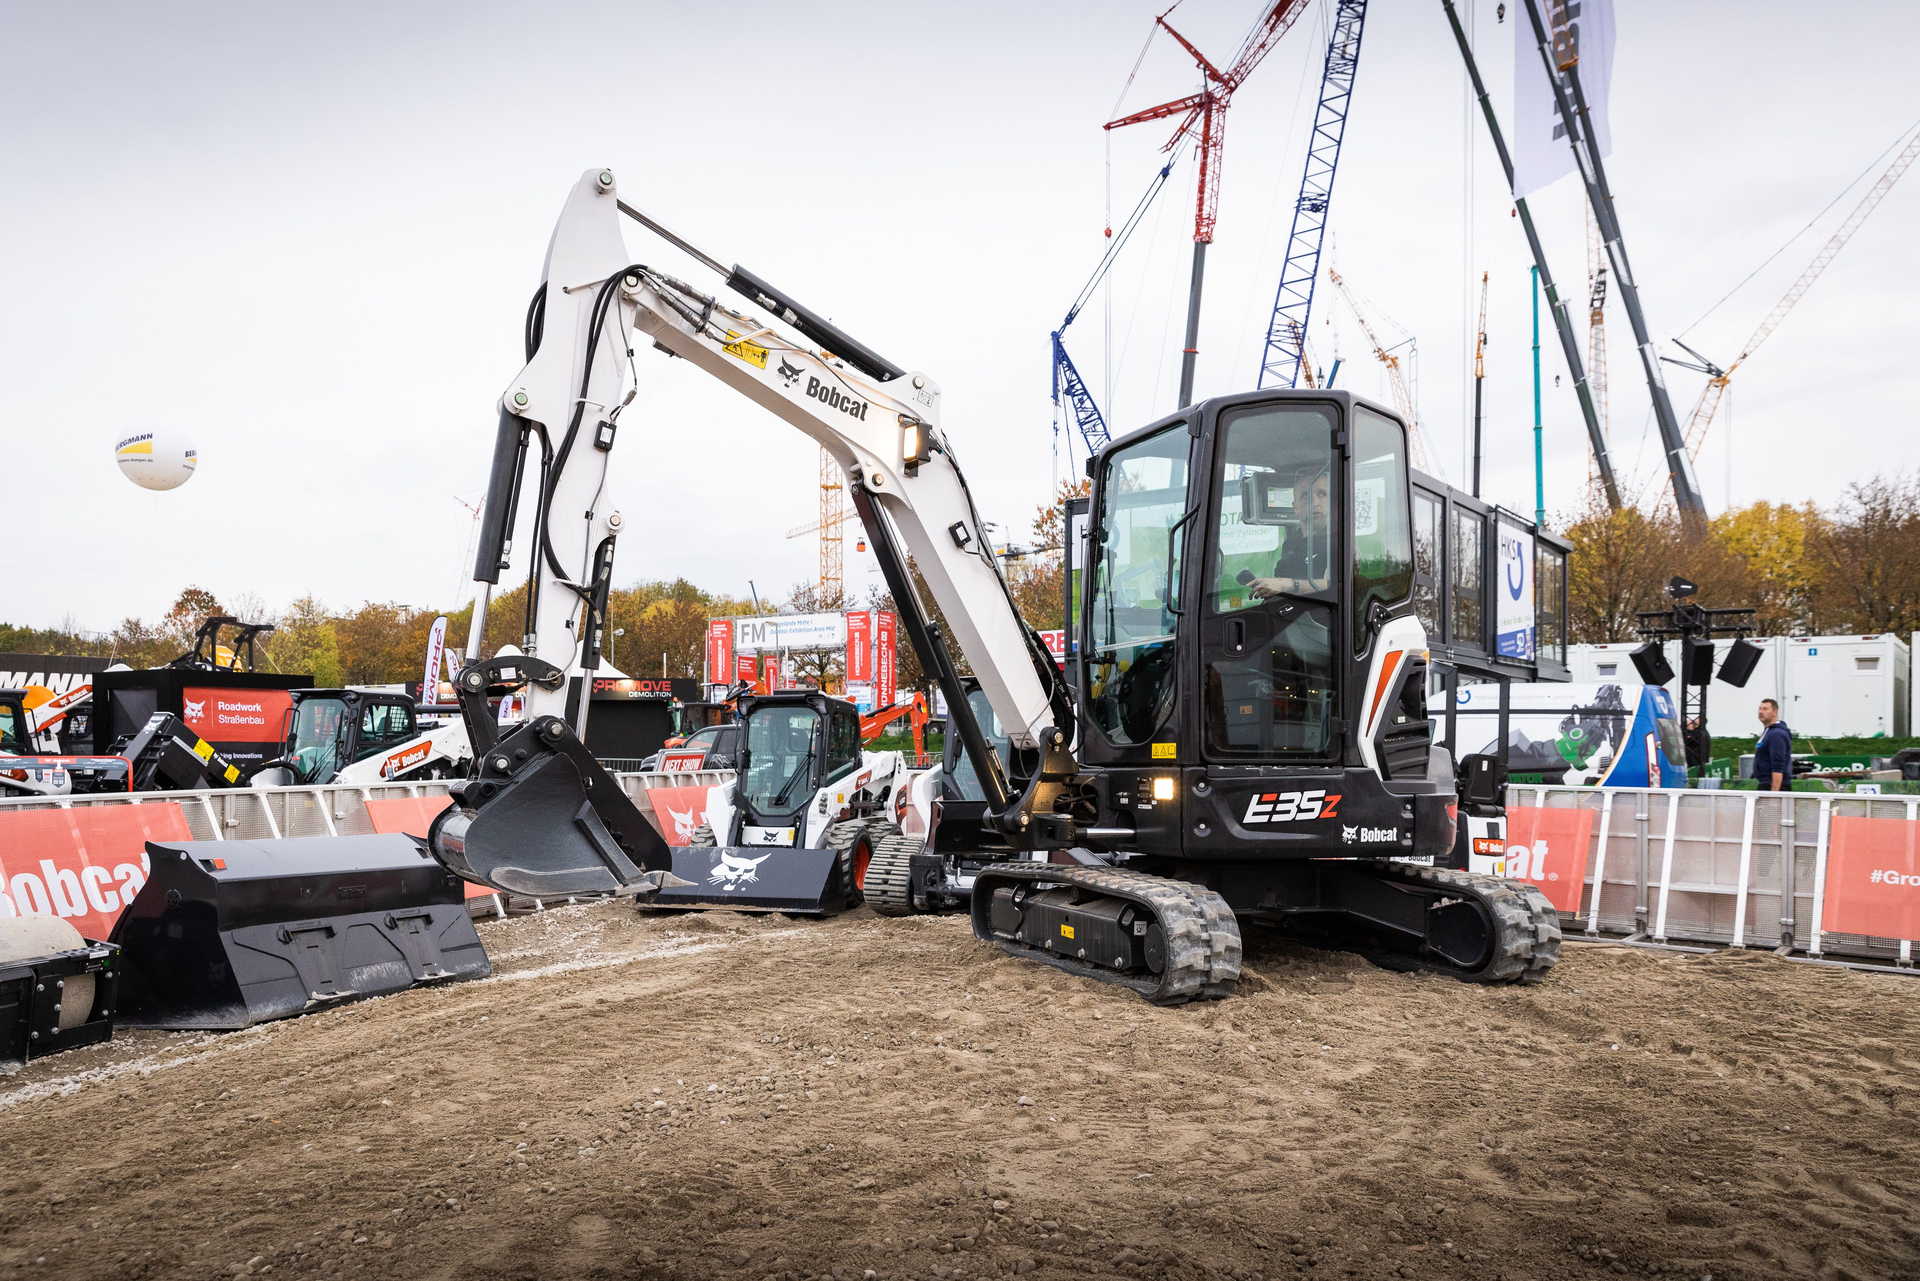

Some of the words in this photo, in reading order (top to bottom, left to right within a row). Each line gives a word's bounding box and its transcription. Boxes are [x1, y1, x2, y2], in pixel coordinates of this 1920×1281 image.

[806, 375, 868, 422] Bobcat
[1501, 534, 1516, 560] HKS
[741, 623, 766, 644] FM
[789, 625, 813, 633] Exhibition
[593, 680, 671, 694] PROMOVE
[218, 701, 262, 713] Roadwork
[218, 714, 265, 725] Straßenbau
[402, 749, 425, 767] Bobcat
[664, 759, 682, 772] NEXT
[681, 758, 702, 771] SHOW
[1360, 827, 1398, 843] Bobcat
[1870, 869, 1920, 887] #Gro
